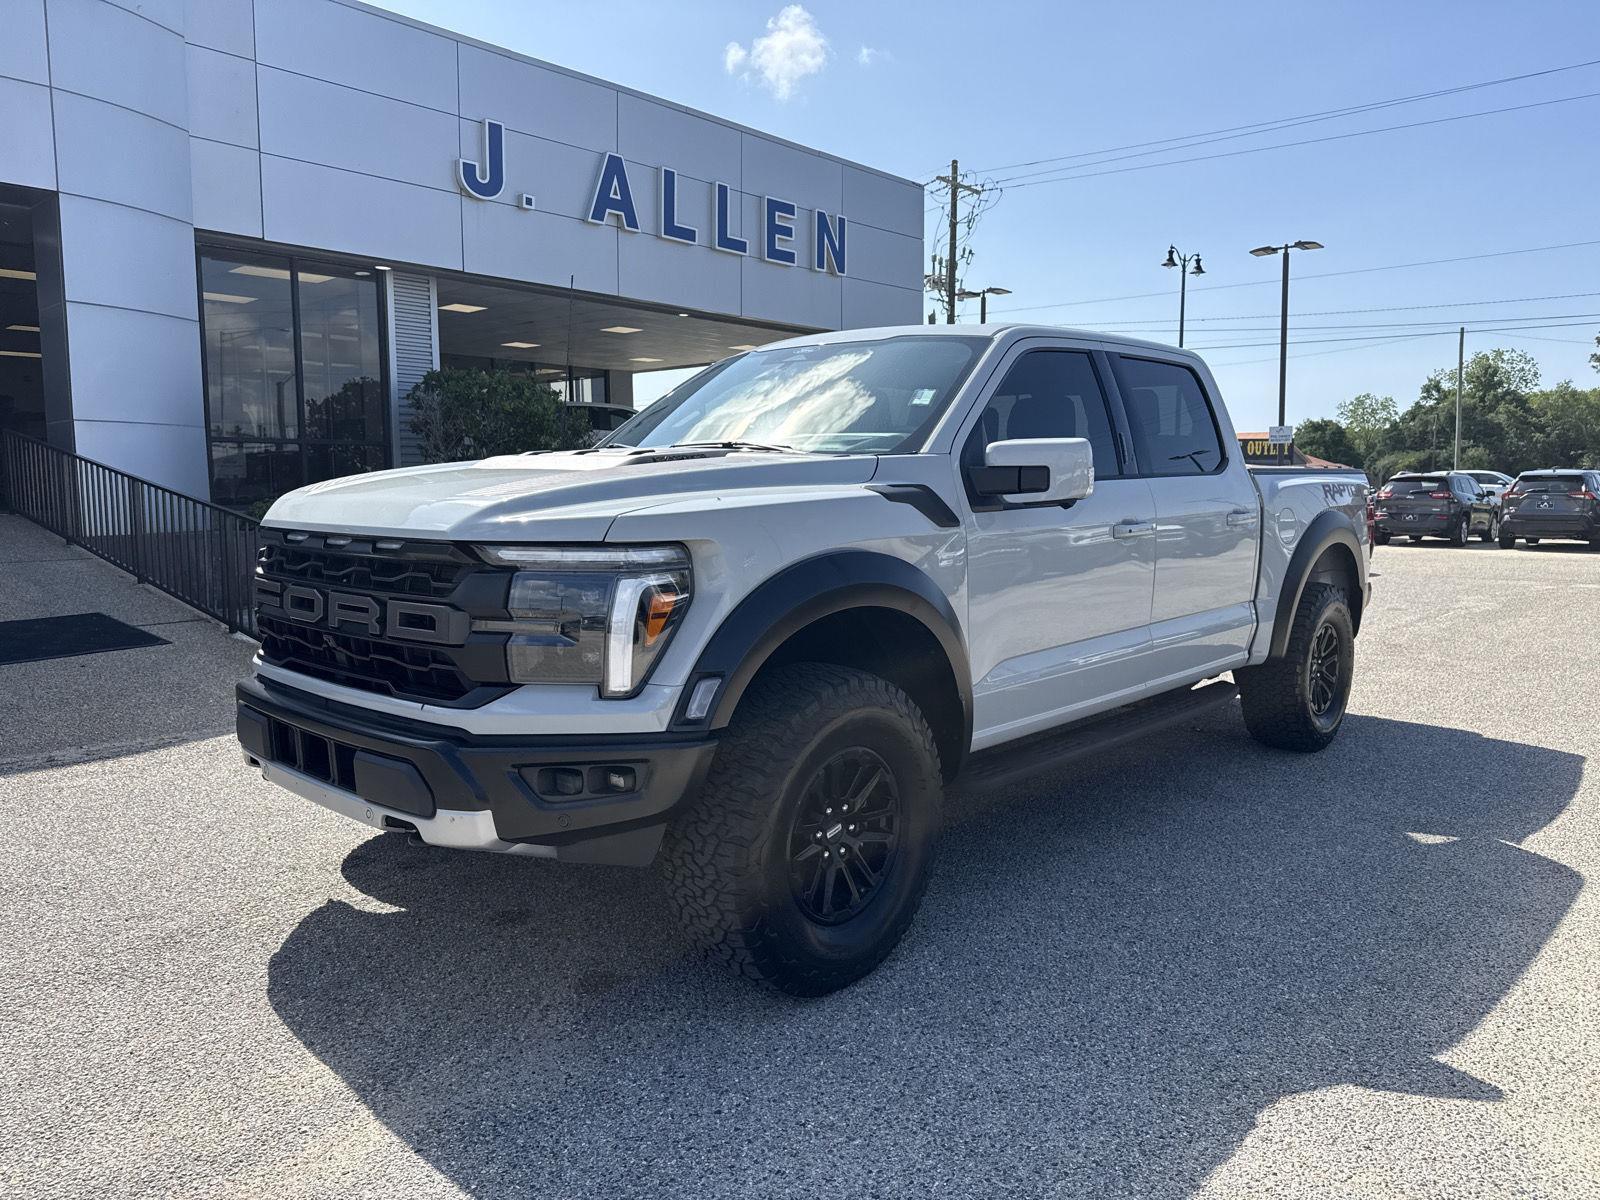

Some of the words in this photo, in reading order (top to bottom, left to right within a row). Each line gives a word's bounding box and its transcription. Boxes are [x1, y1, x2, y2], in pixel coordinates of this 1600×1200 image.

[587, 151, 848, 277] ALLEN
[1247, 441, 1289, 455] OUTLT
[254, 577, 470, 644] FORD
